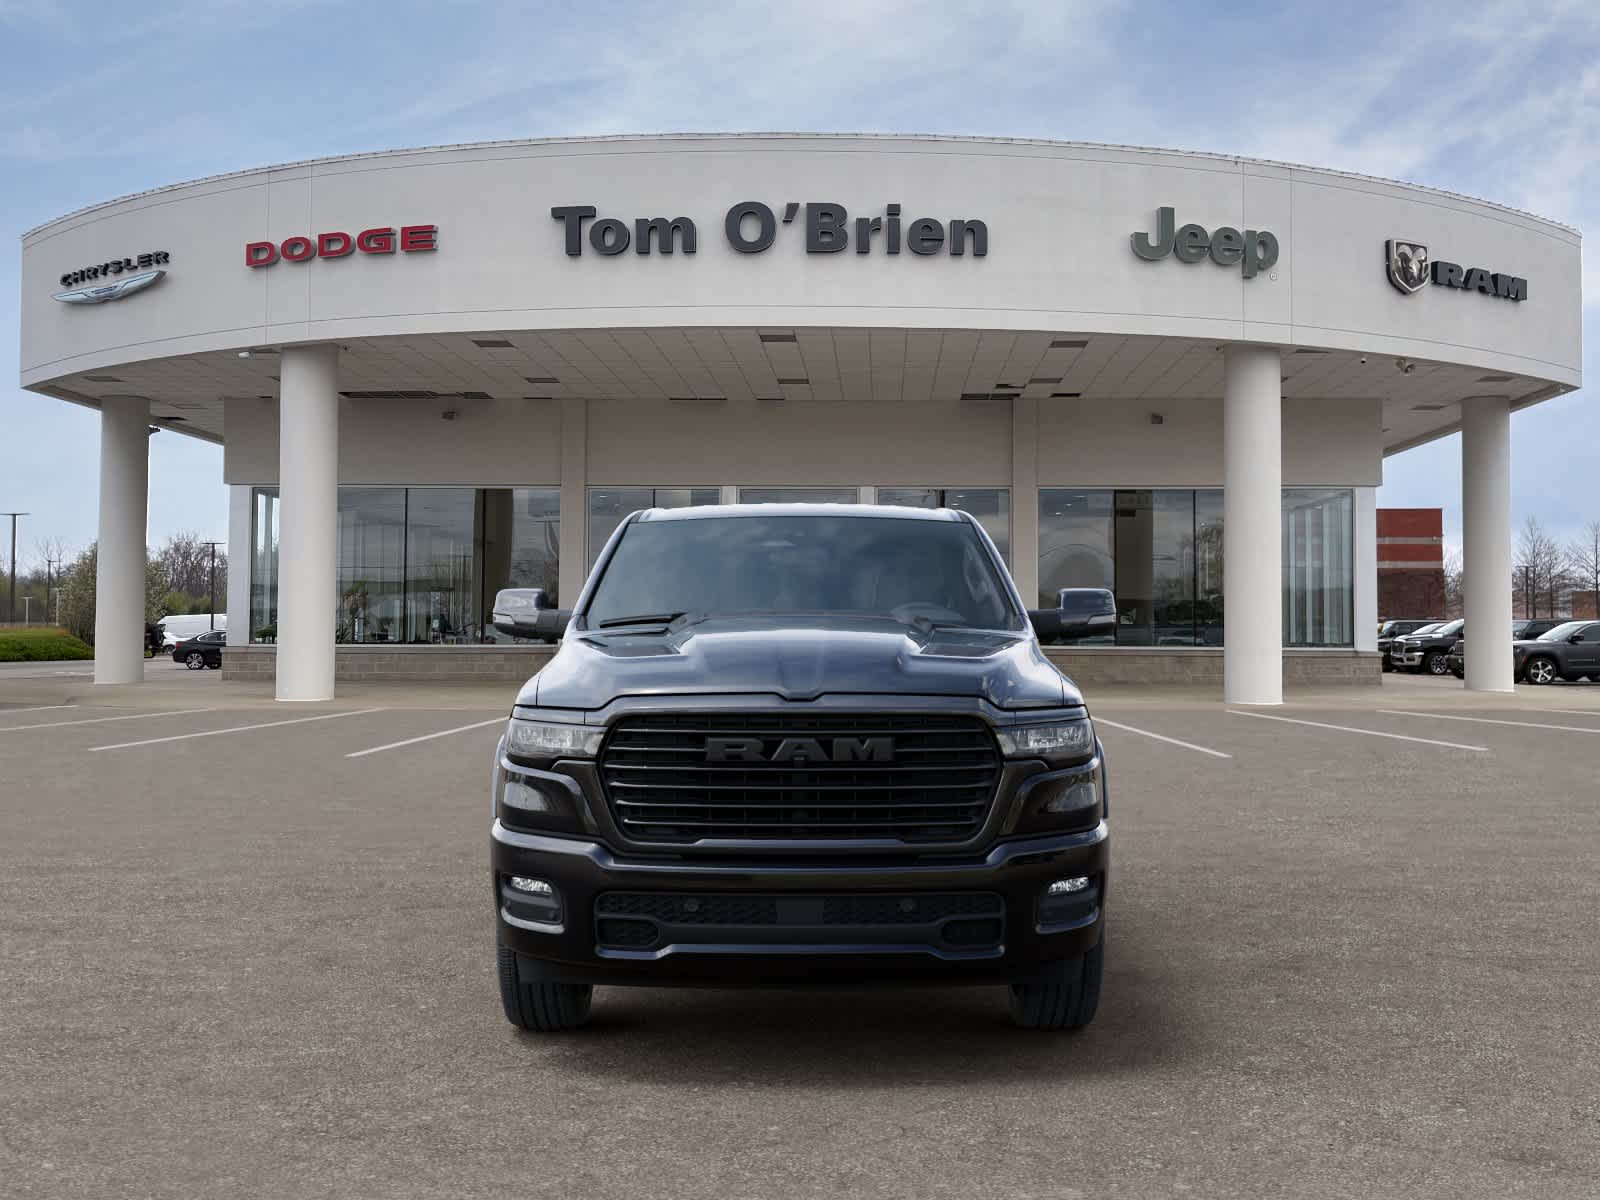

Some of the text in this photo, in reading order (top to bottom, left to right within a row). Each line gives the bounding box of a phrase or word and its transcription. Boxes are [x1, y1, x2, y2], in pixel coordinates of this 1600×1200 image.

[245, 225, 438, 269] DODGE
[551, 200, 988, 257] Tom O'Brien
[1130, 206, 1279, 279] Jeep
[60, 250, 170, 288] CHRYSLER
[1430, 260, 1528, 302] RAM
[703, 735, 896, 763] RAM
